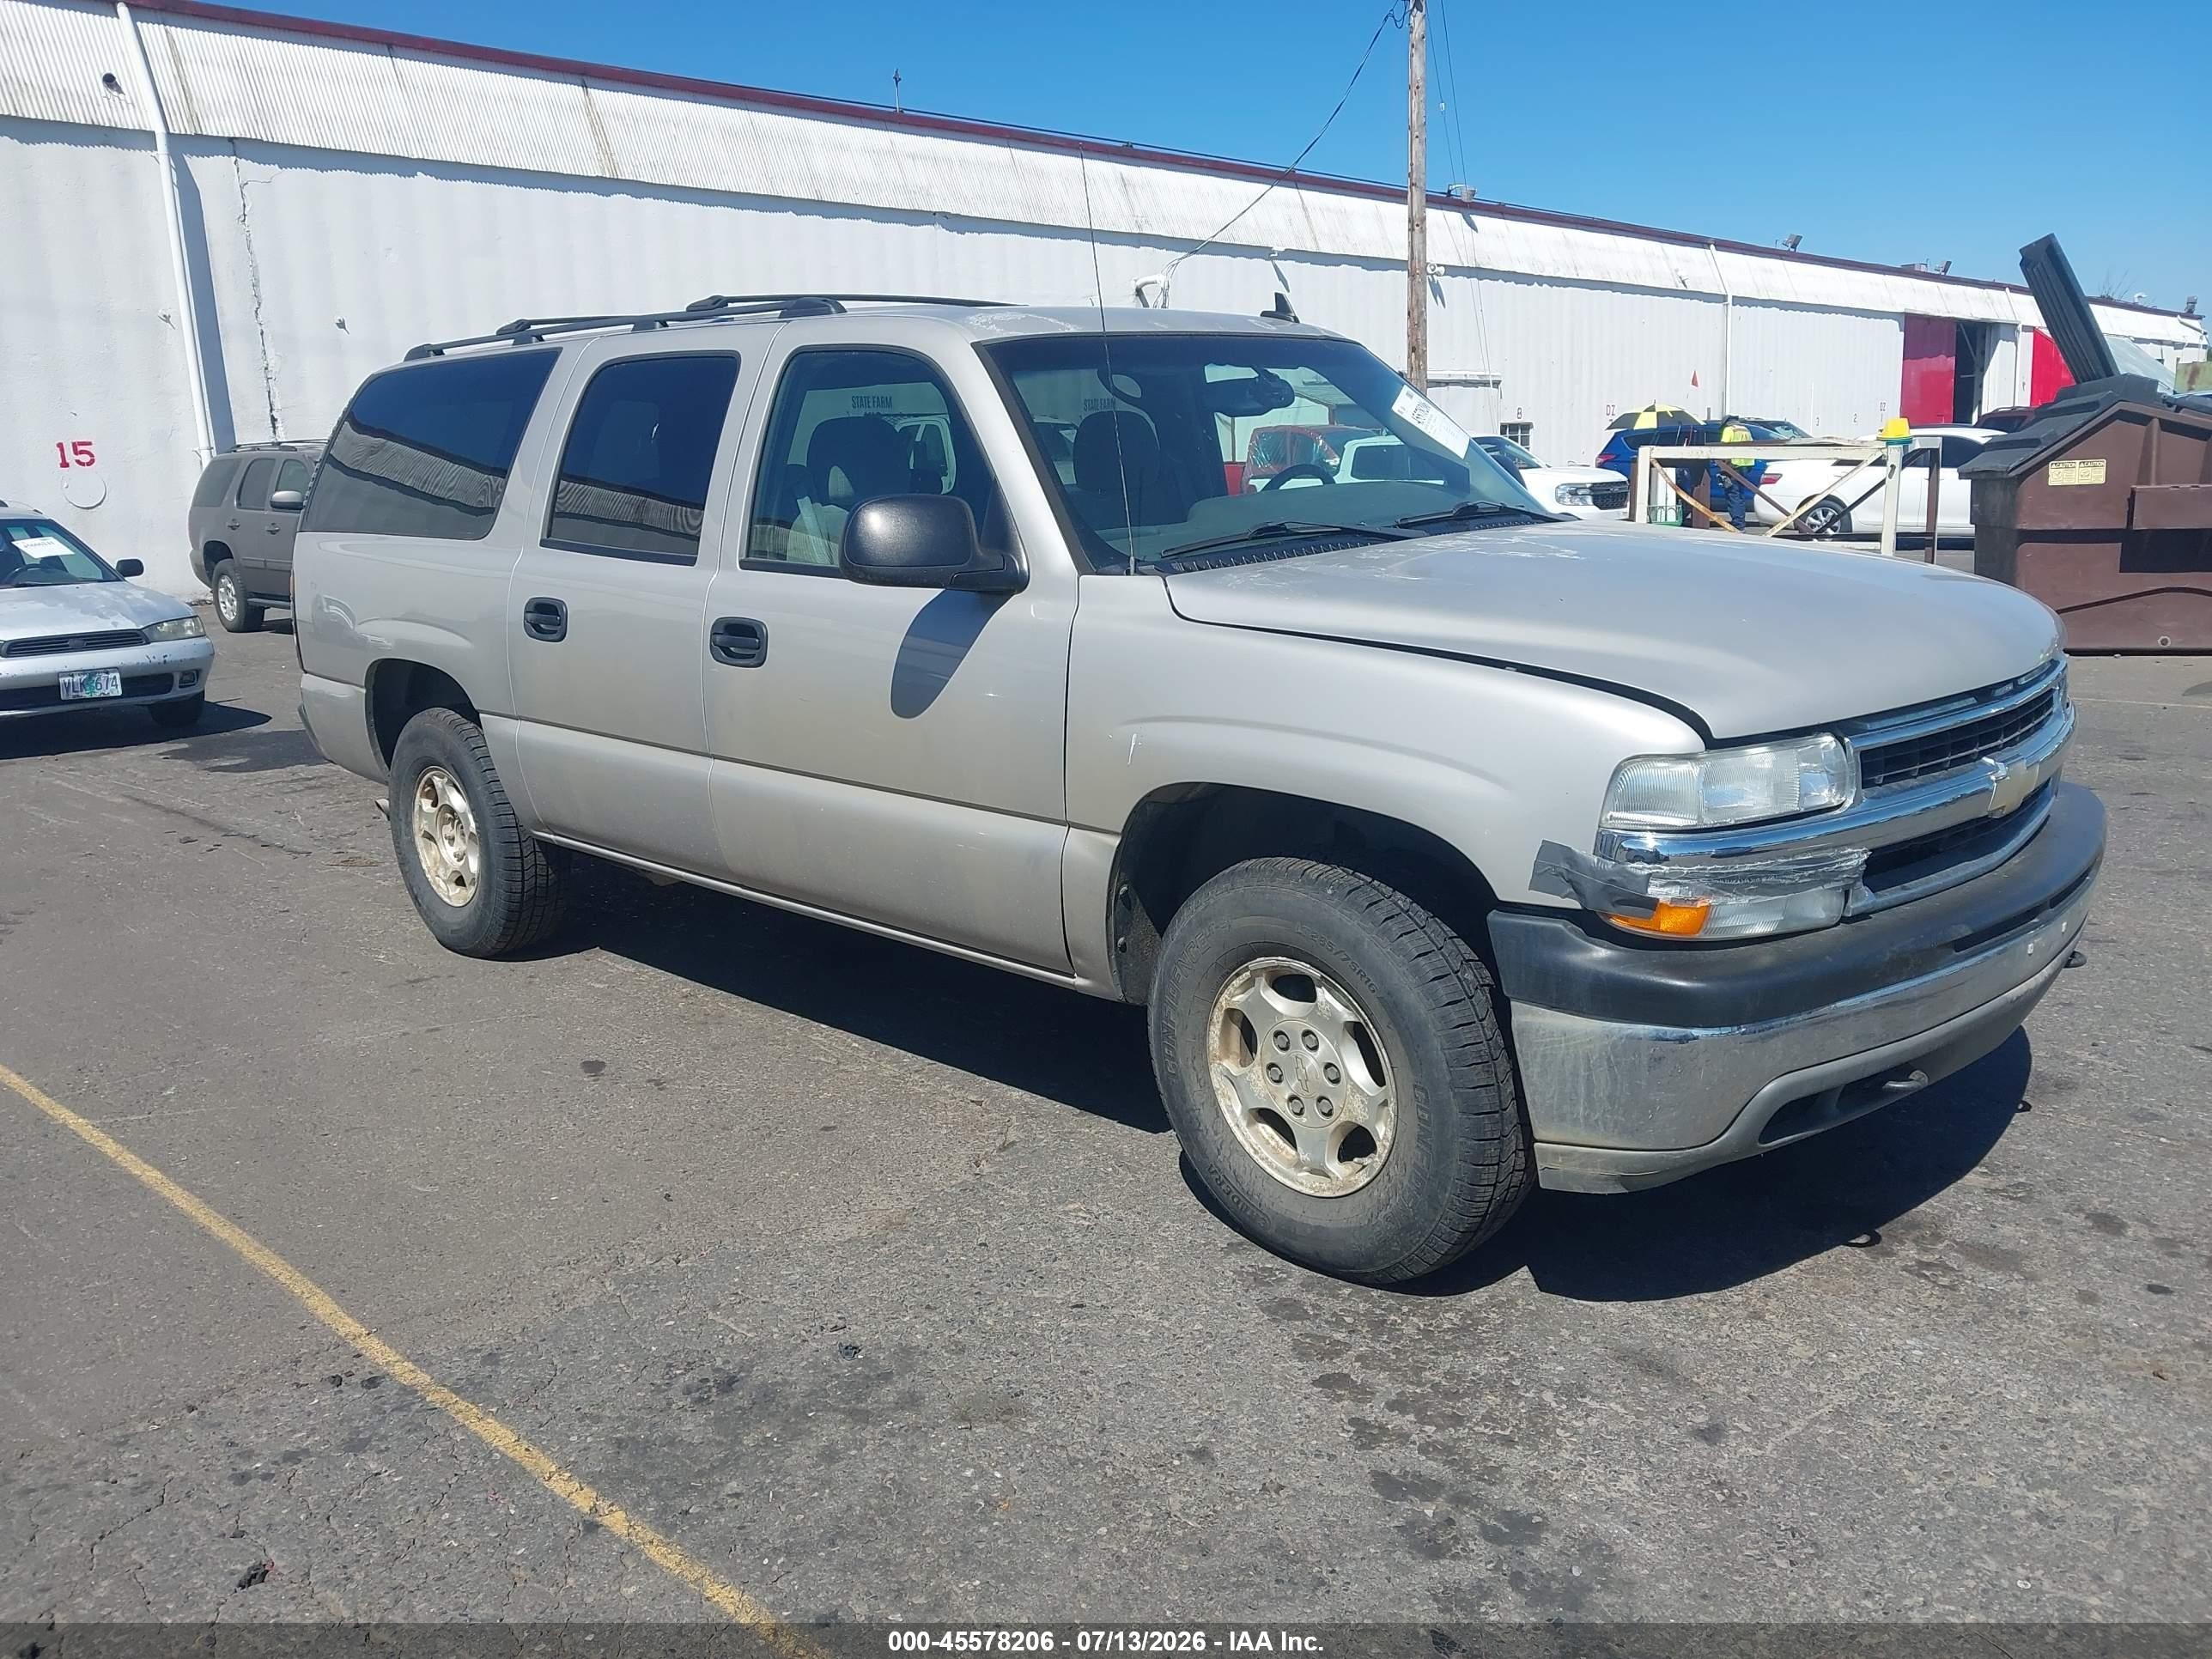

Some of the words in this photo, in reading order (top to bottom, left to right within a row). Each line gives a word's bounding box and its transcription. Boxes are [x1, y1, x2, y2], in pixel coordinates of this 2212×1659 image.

[851, 395, 871, 409] STATE
[872, 395, 893, 409] FARM
[56, 441, 96, 468] 15
[94, 674, 118, 690] 674
